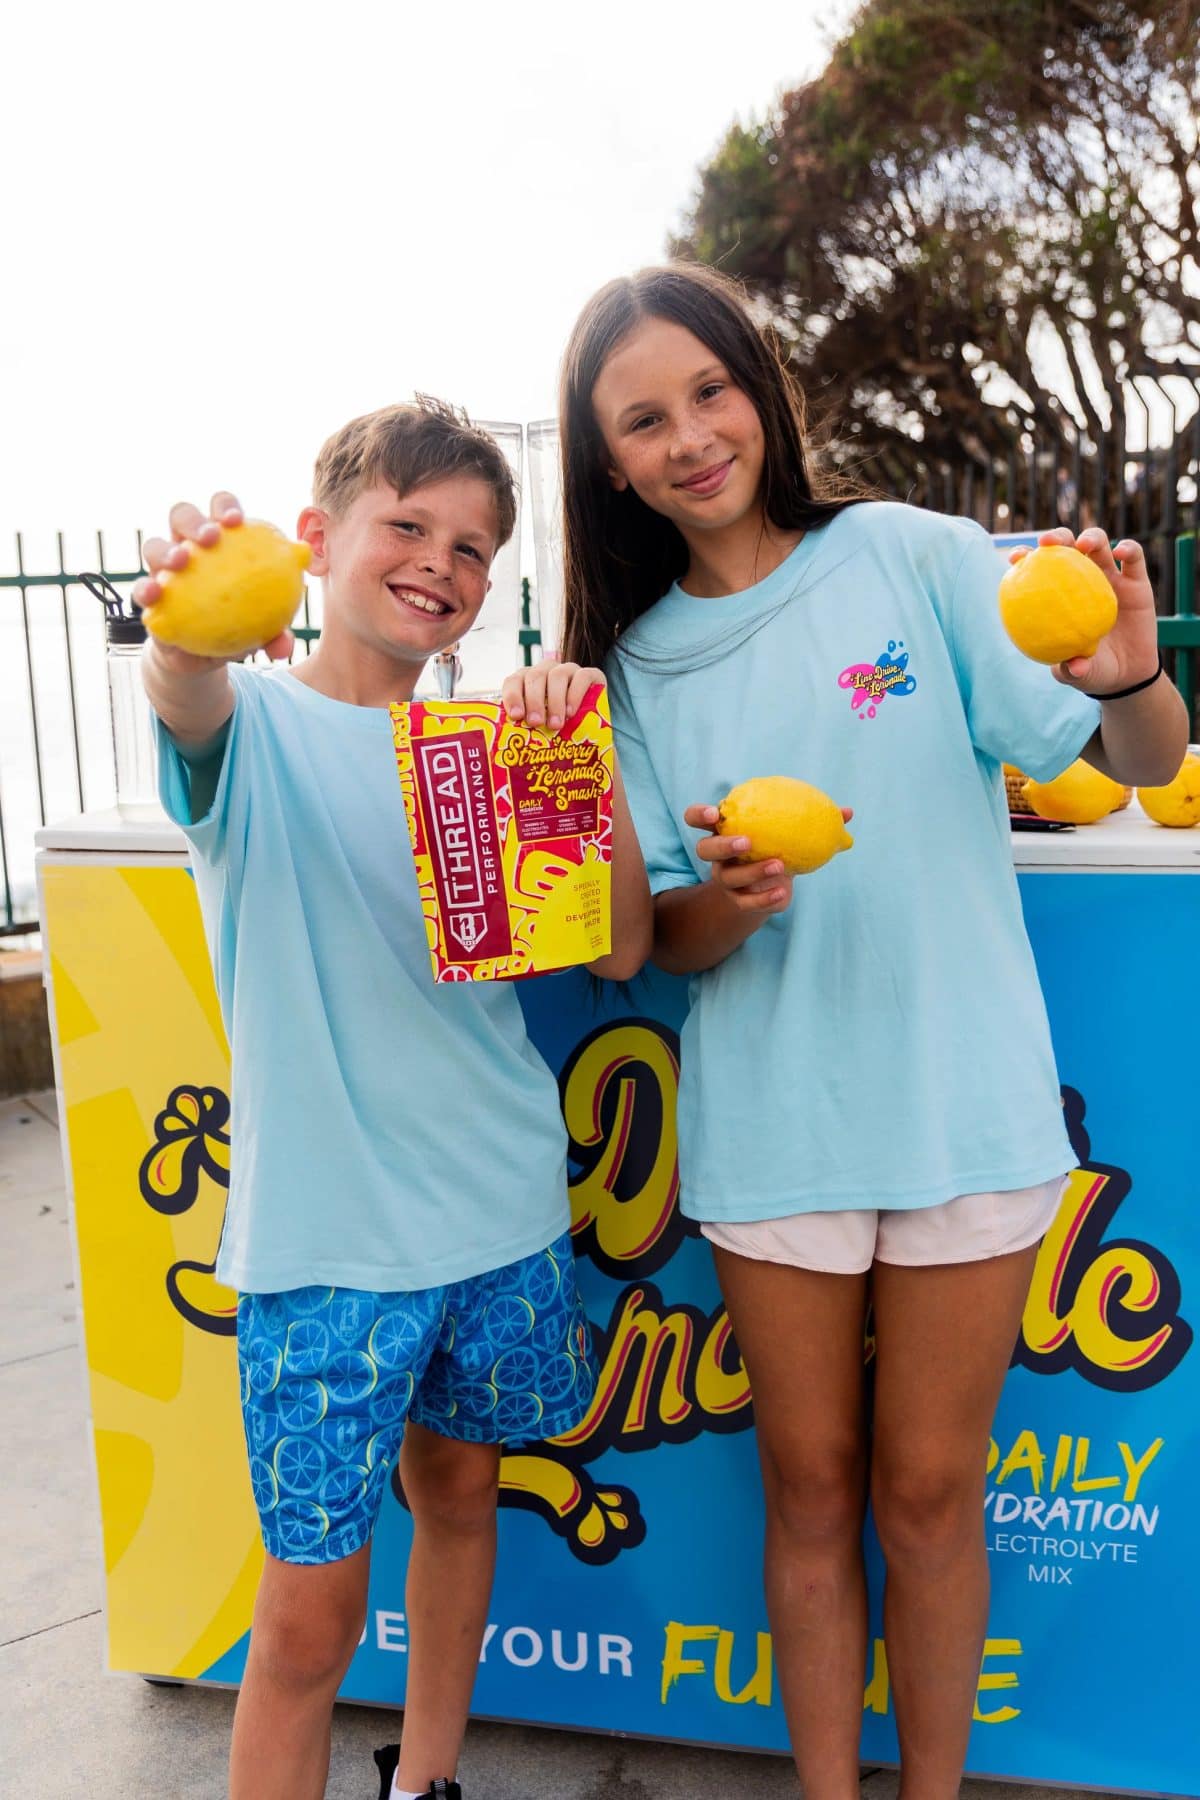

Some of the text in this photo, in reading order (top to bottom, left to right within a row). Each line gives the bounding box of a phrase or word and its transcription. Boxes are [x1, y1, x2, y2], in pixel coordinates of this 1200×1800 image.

[874, 664, 898, 680] Drive
[503, 734, 598, 767] Strawberry
[527, 761, 604, 794] Lemonade
[519, 798, 543, 809] DAILY
[556, 783, 599, 811] Smash
[432, 752, 475, 900] THREAD
[470, 747, 498, 895] PERFORMANCE
[984, 1491, 1160, 1536] DRATION
[986, 1533, 1138, 1563] ECTROLYTE
[1028, 1564, 1073, 1585] MIX
